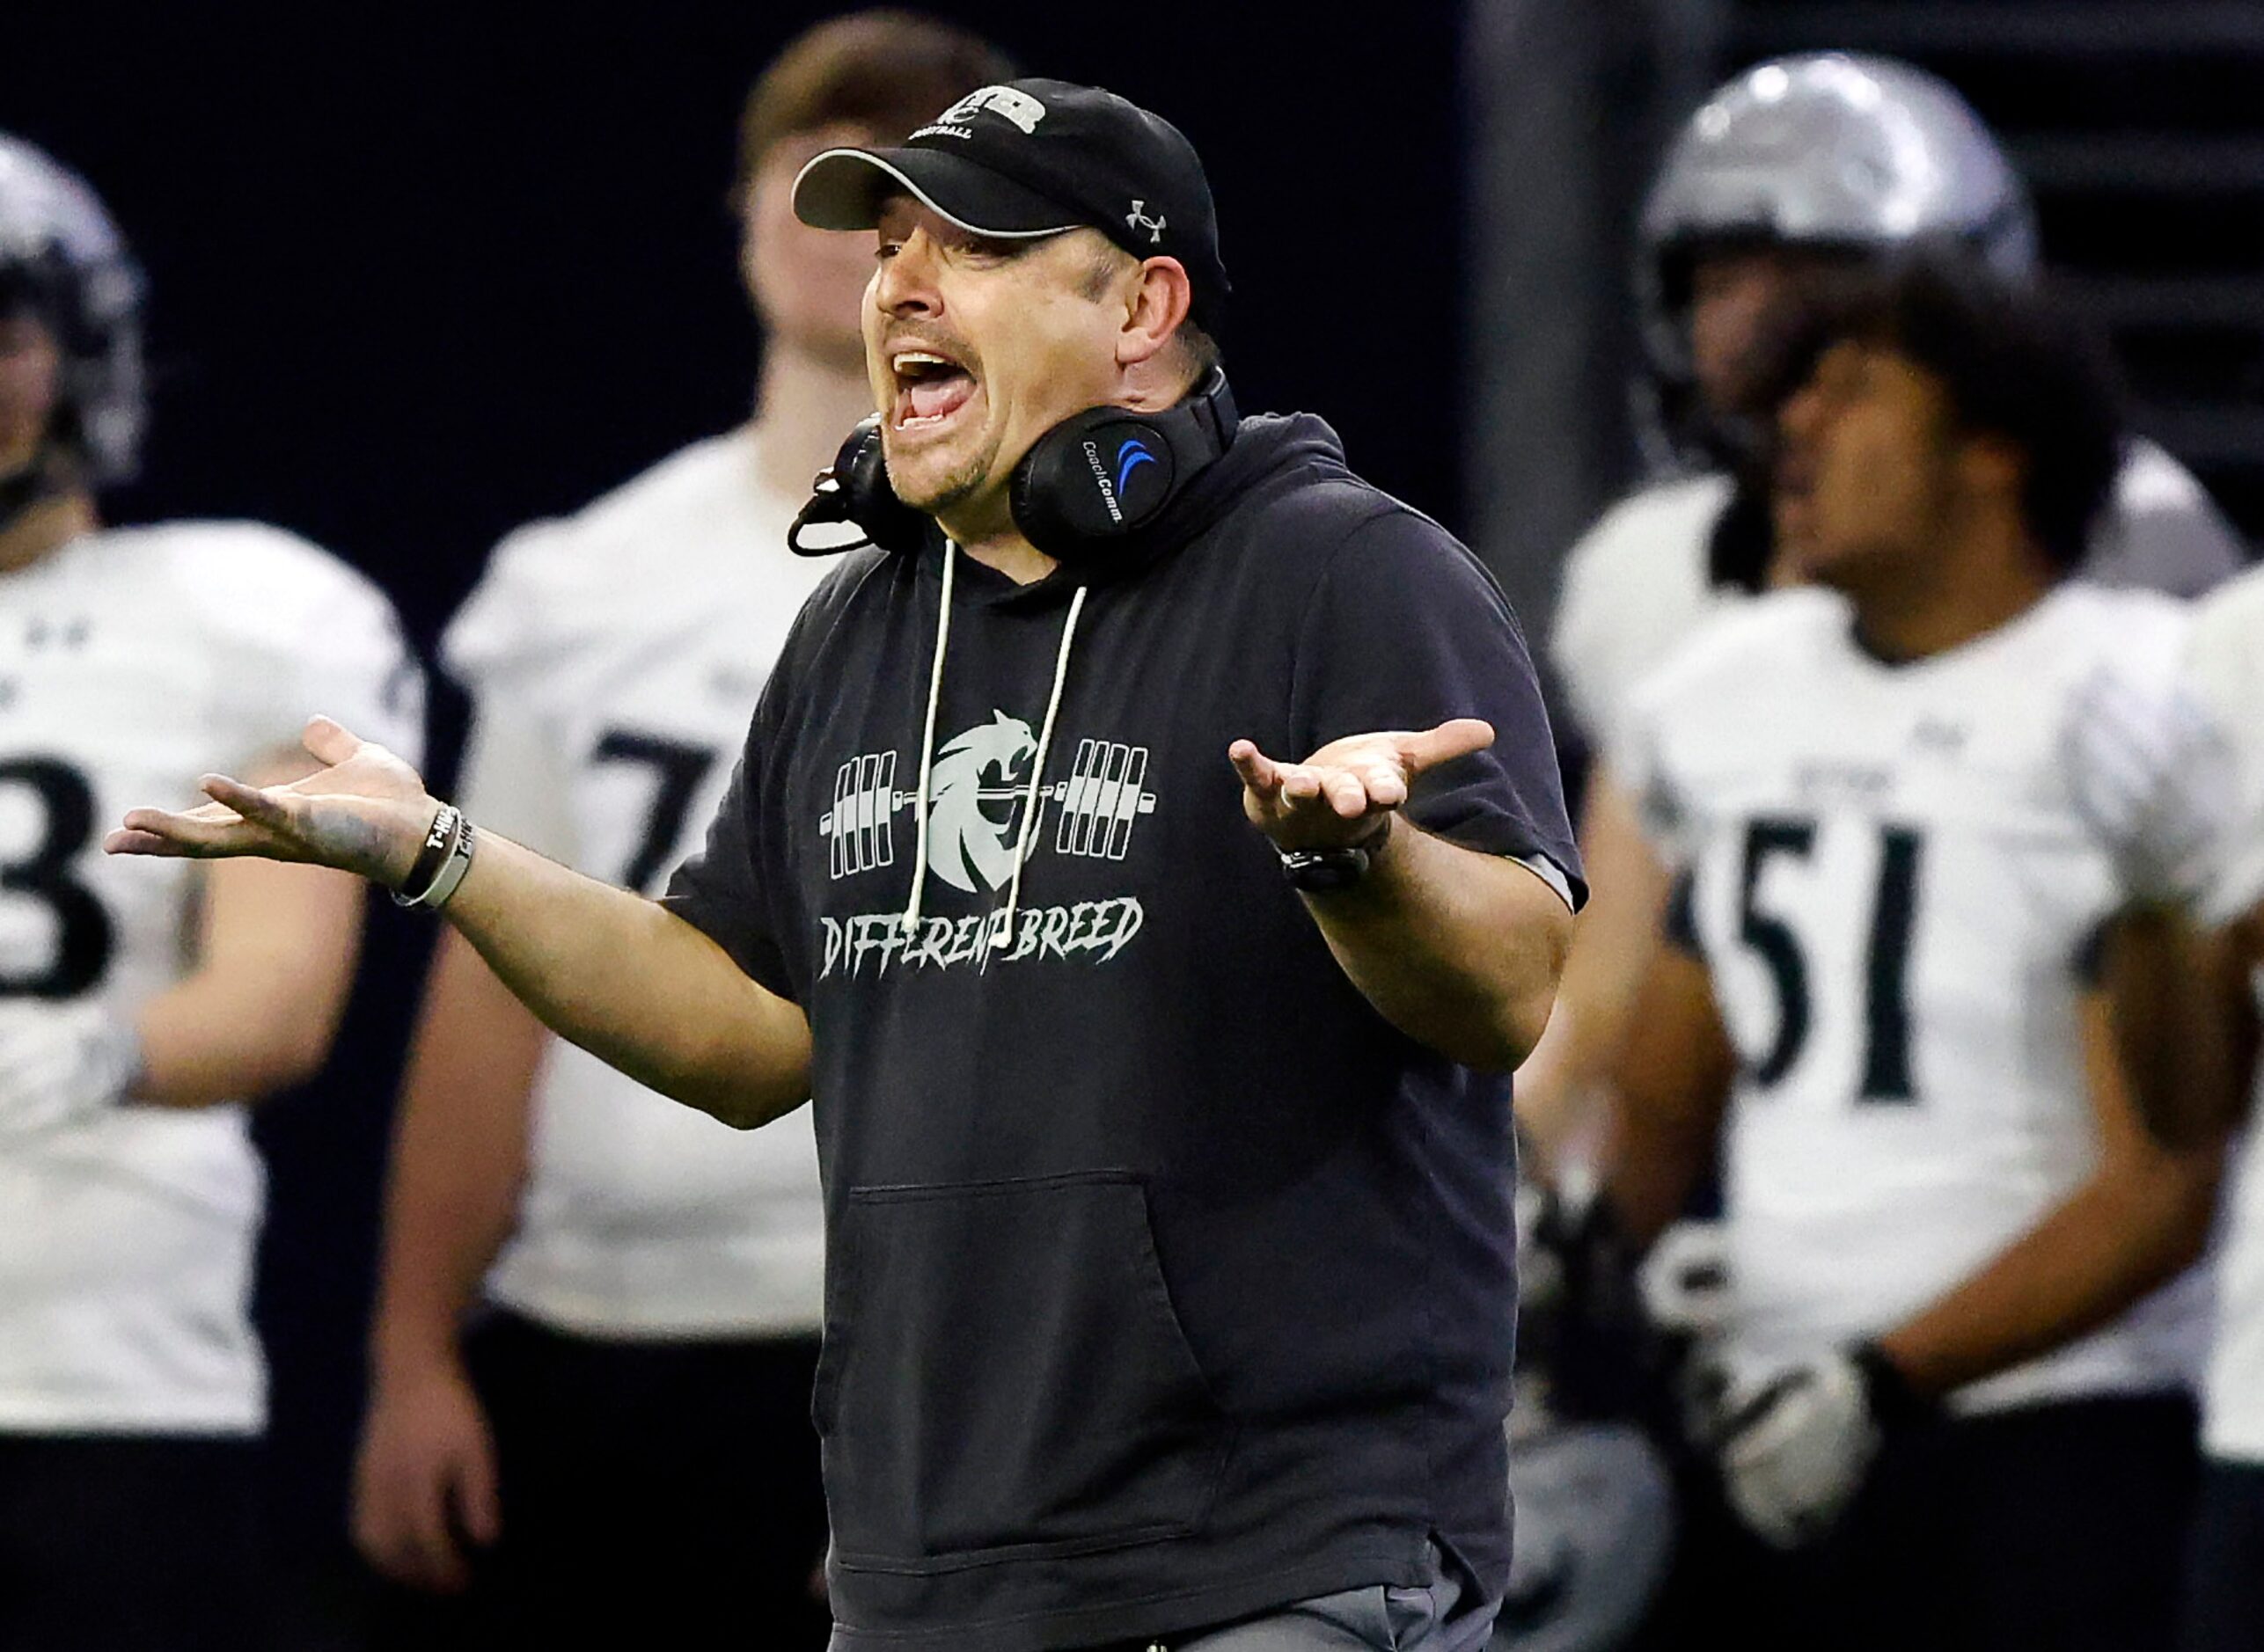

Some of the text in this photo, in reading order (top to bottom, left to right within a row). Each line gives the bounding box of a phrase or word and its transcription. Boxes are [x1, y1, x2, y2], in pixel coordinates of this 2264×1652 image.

[1082, 441, 1123, 524] CoachComm
[818, 896, 1144, 981] DIFFERENT BREED
[1735, 814, 1925, 1105] 51
